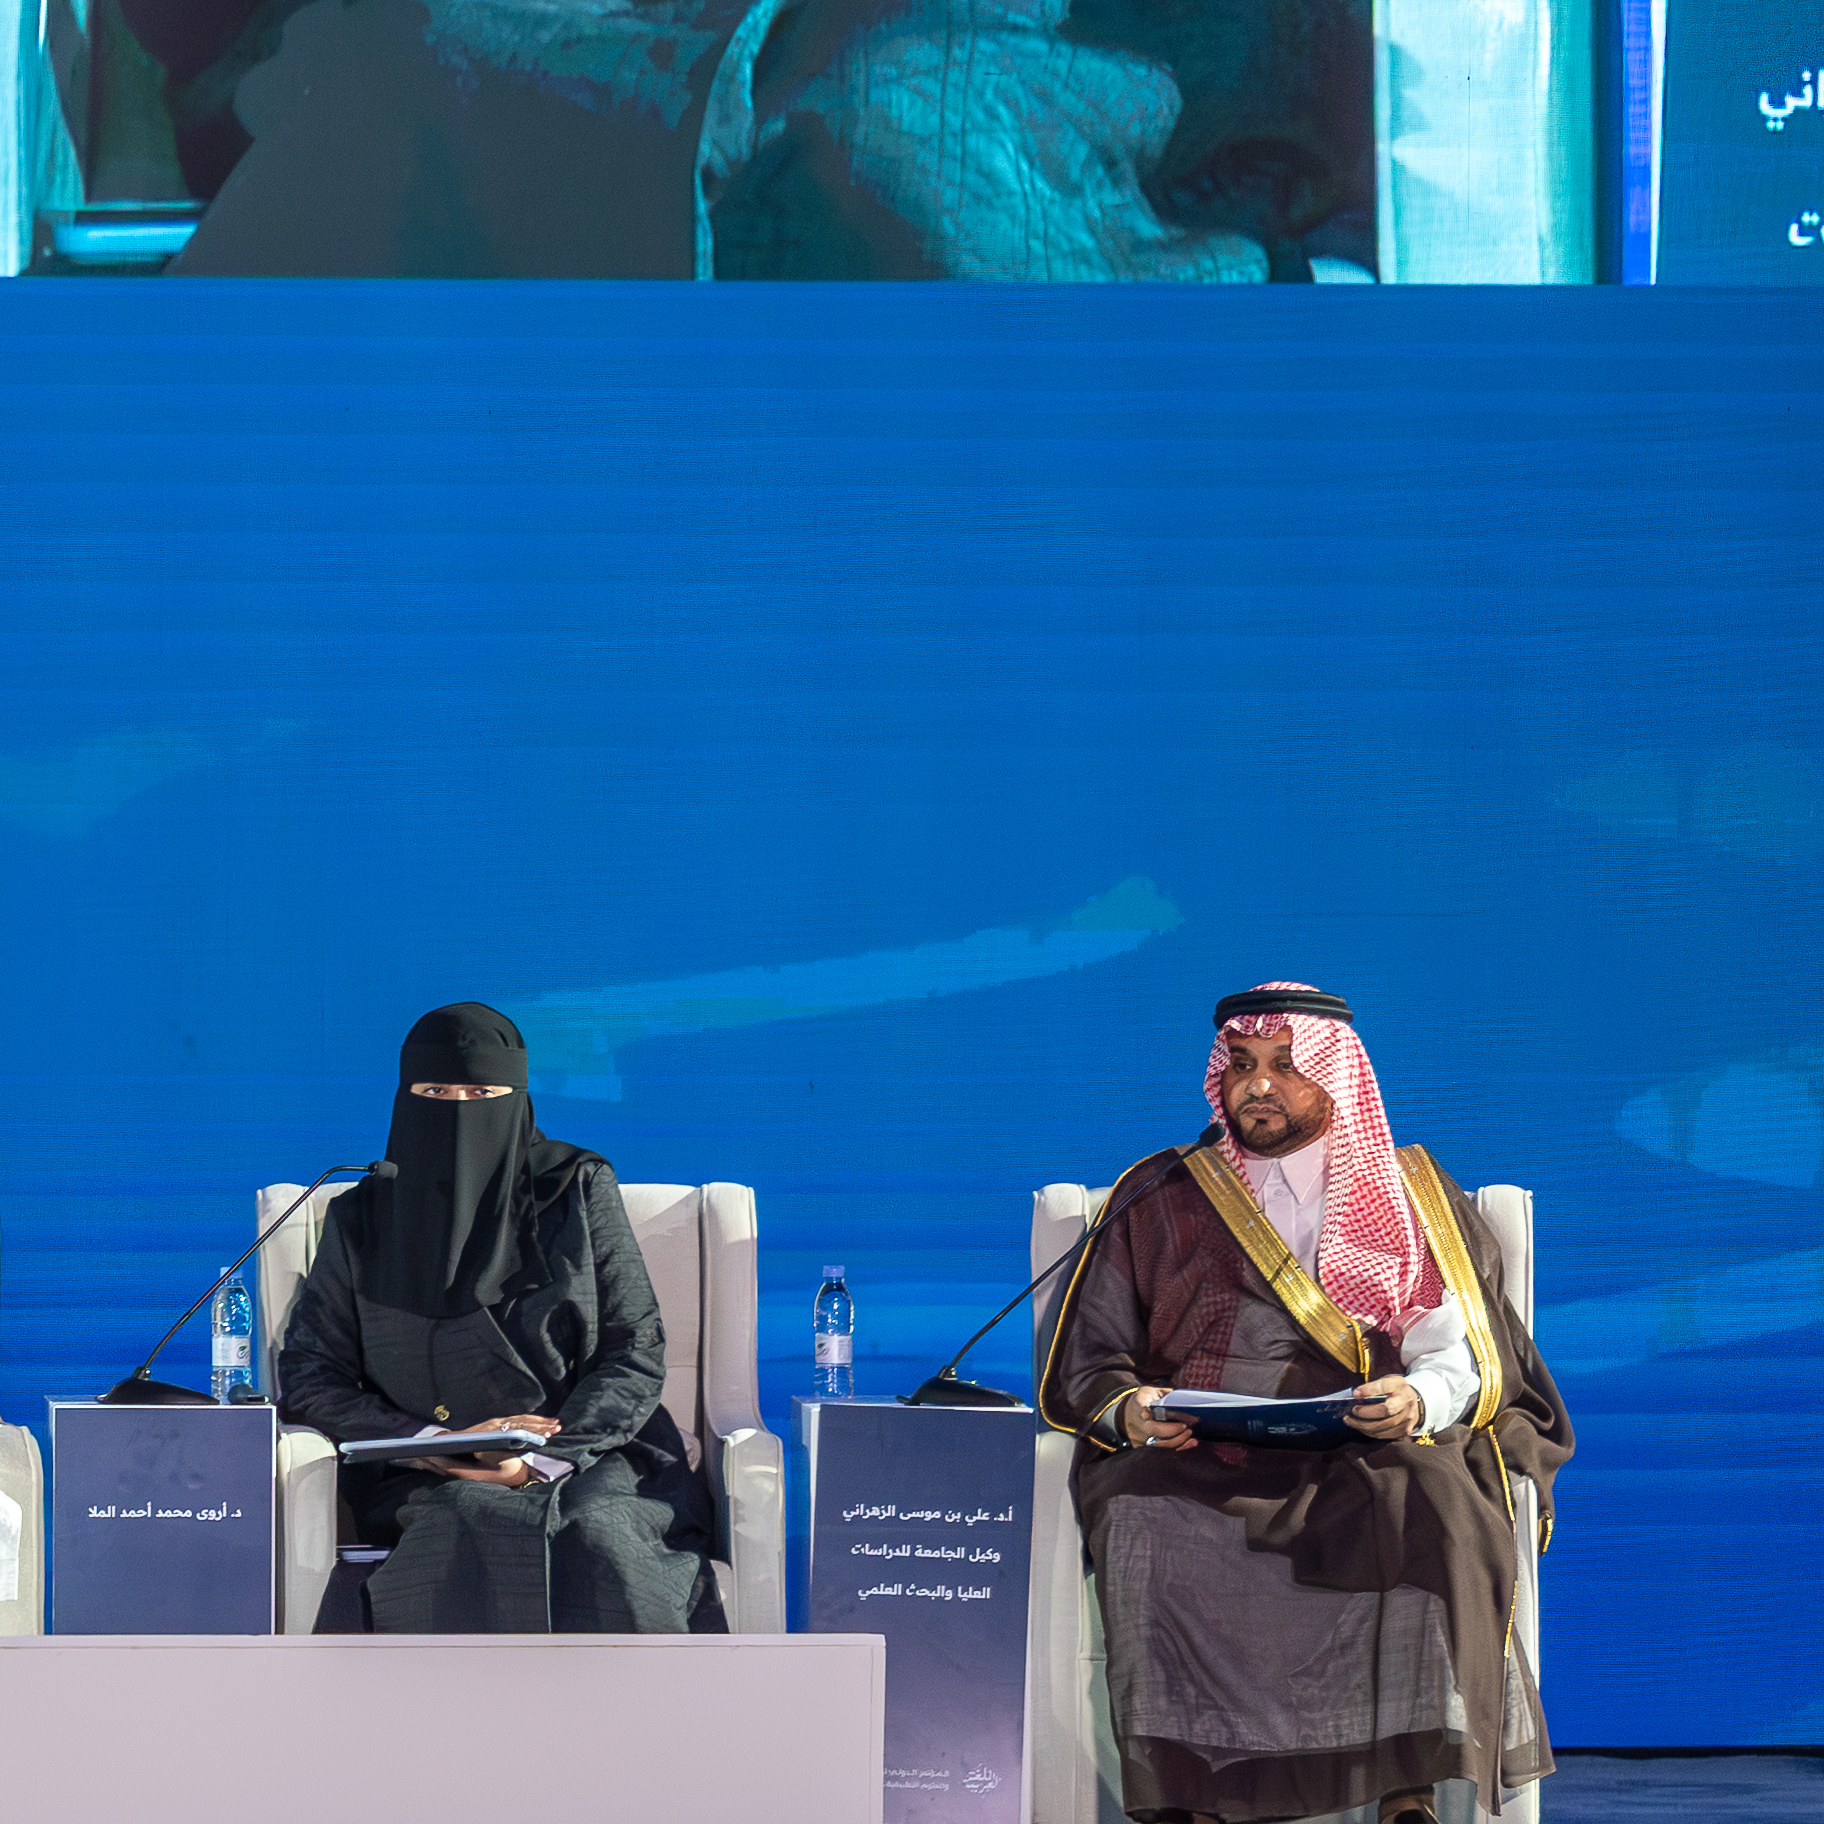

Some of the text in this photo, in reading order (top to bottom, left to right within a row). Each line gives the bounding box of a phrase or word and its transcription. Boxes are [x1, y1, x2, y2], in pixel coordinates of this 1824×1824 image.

[88, 1501, 242, 1521] د. أروى محمد أحمد الملا
[842, 1503, 896, 1522] الزهراني
[899, 1510, 942, 1521] موسى
[944, 1510, 961, 1523] بن
[964, 1508, 990, 1527] علي
[851, 1543, 1001, 1563] وكيل الجامعة للدراسات
[857, 1583, 991, 1602] العليا والبحث العلمي
